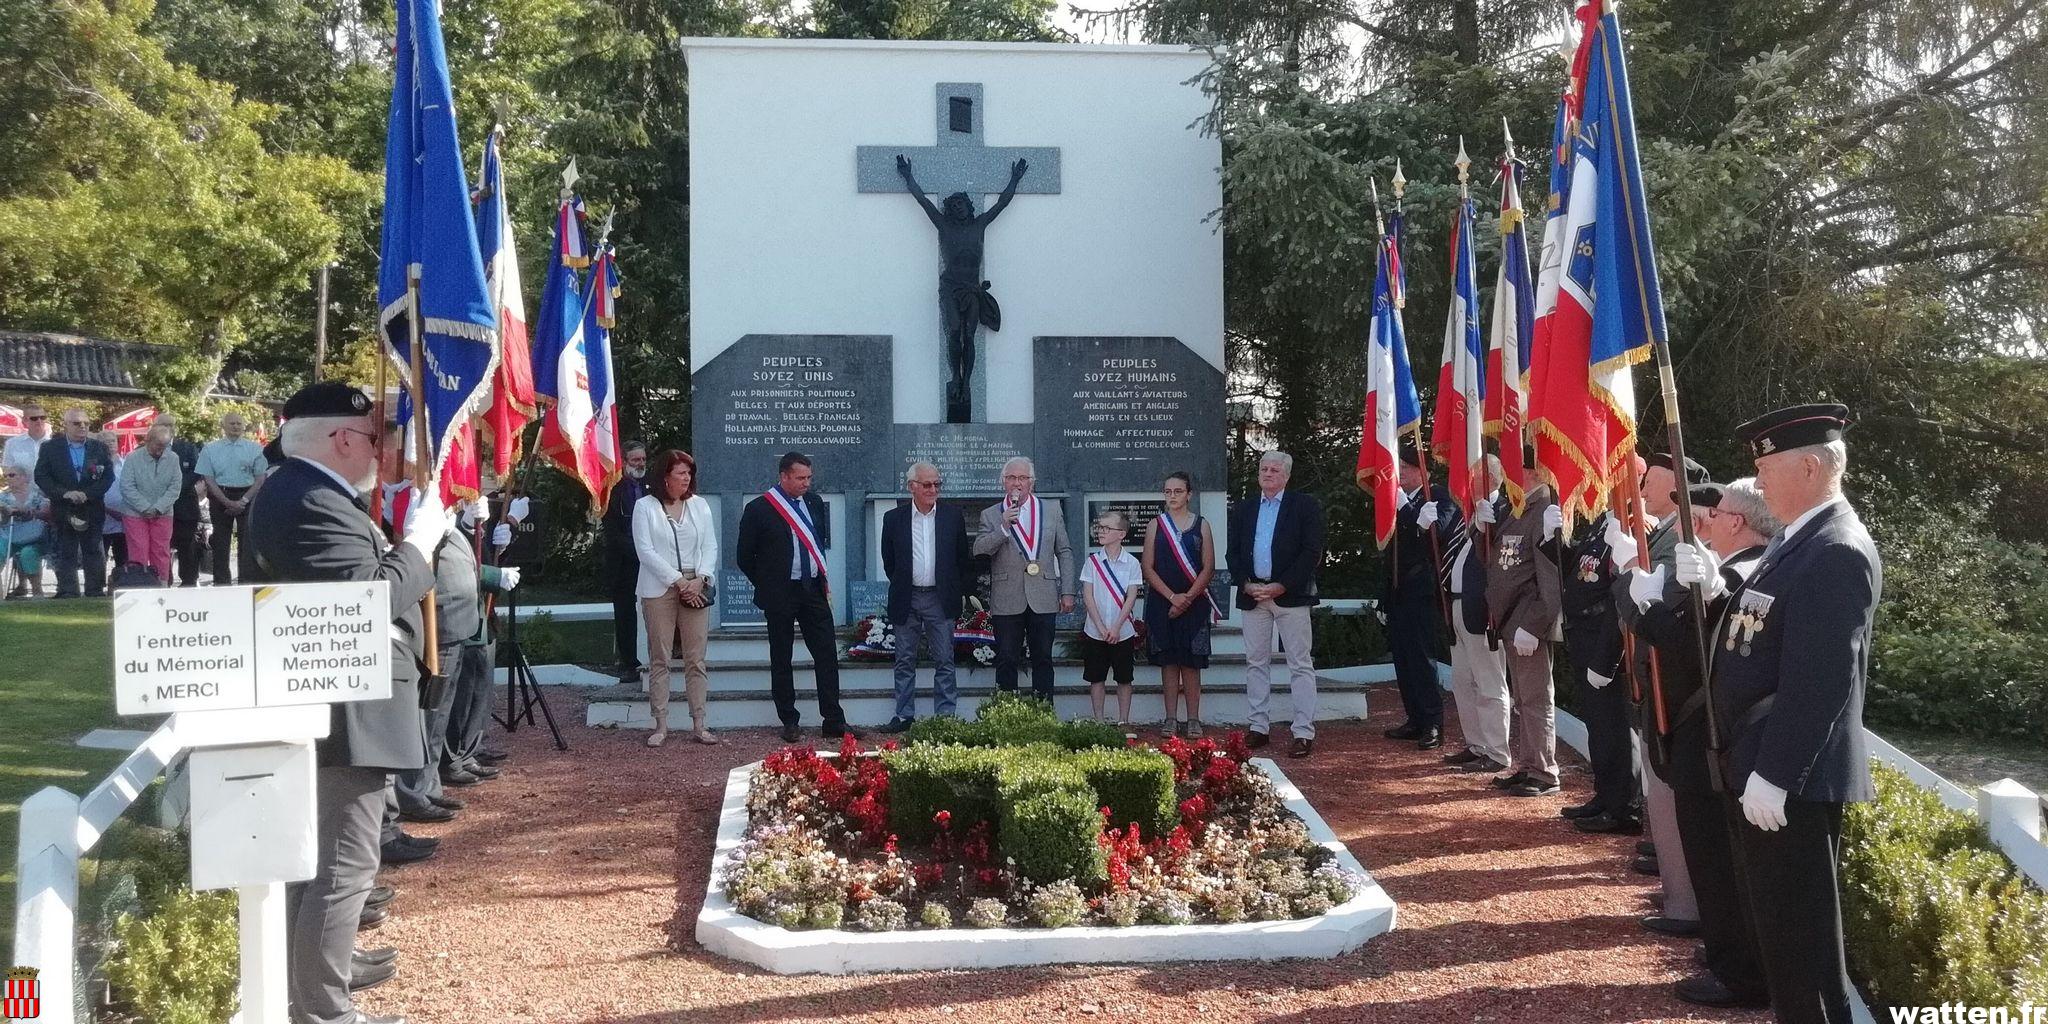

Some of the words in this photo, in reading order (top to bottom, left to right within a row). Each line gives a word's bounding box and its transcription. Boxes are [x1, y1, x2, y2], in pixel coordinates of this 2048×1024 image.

[763, 357, 823, 367] PEUPLES
[1103, 359, 1157, 369] PEUPLES
[753, 371, 794, 381] SOYEZ
[805, 371, 834, 381] UNIS
[1084, 373, 1122, 382] SOYEZ
[1128, 373, 1177, 382] HUMAINS
[808, 390, 856, 398] POLITIQUES
[734, 401, 768, 409] BELGES
[1131, 402, 1142, 410] ET
[1146, 402, 1180, 410] ANGLAIS
[820, 424, 862, 432] POLONAIS
[1063, 429, 1104, 437] HOMMAGE
[1116, 429, 1173, 437] AFFECTUEUX
[1184, 429, 1195, 437] DE
[725, 437, 759, 445] RUSSES
[1072, 441, 1083, 449] LA
[1085, 441, 1121, 449] COMMUNE
[285, 604, 328, 618] Voor
[334, 603, 362, 617] het
[165, 609, 209, 623] Pour
[272, 619, 372, 637] onderhoud
[137, 632, 232, 649] l'entretien
[291, 641, 322, 653] van
[330, 637, 358, 651] het
[124, 660, 149, 673] du
[157, 654, 244, 672] Mémorial
[283, 652, 377, 671] Memoriaal
[287, 676, 339, 692] DANK
[347, 675, 360, 689] U
[156, 682, 219, 700] MERCI
